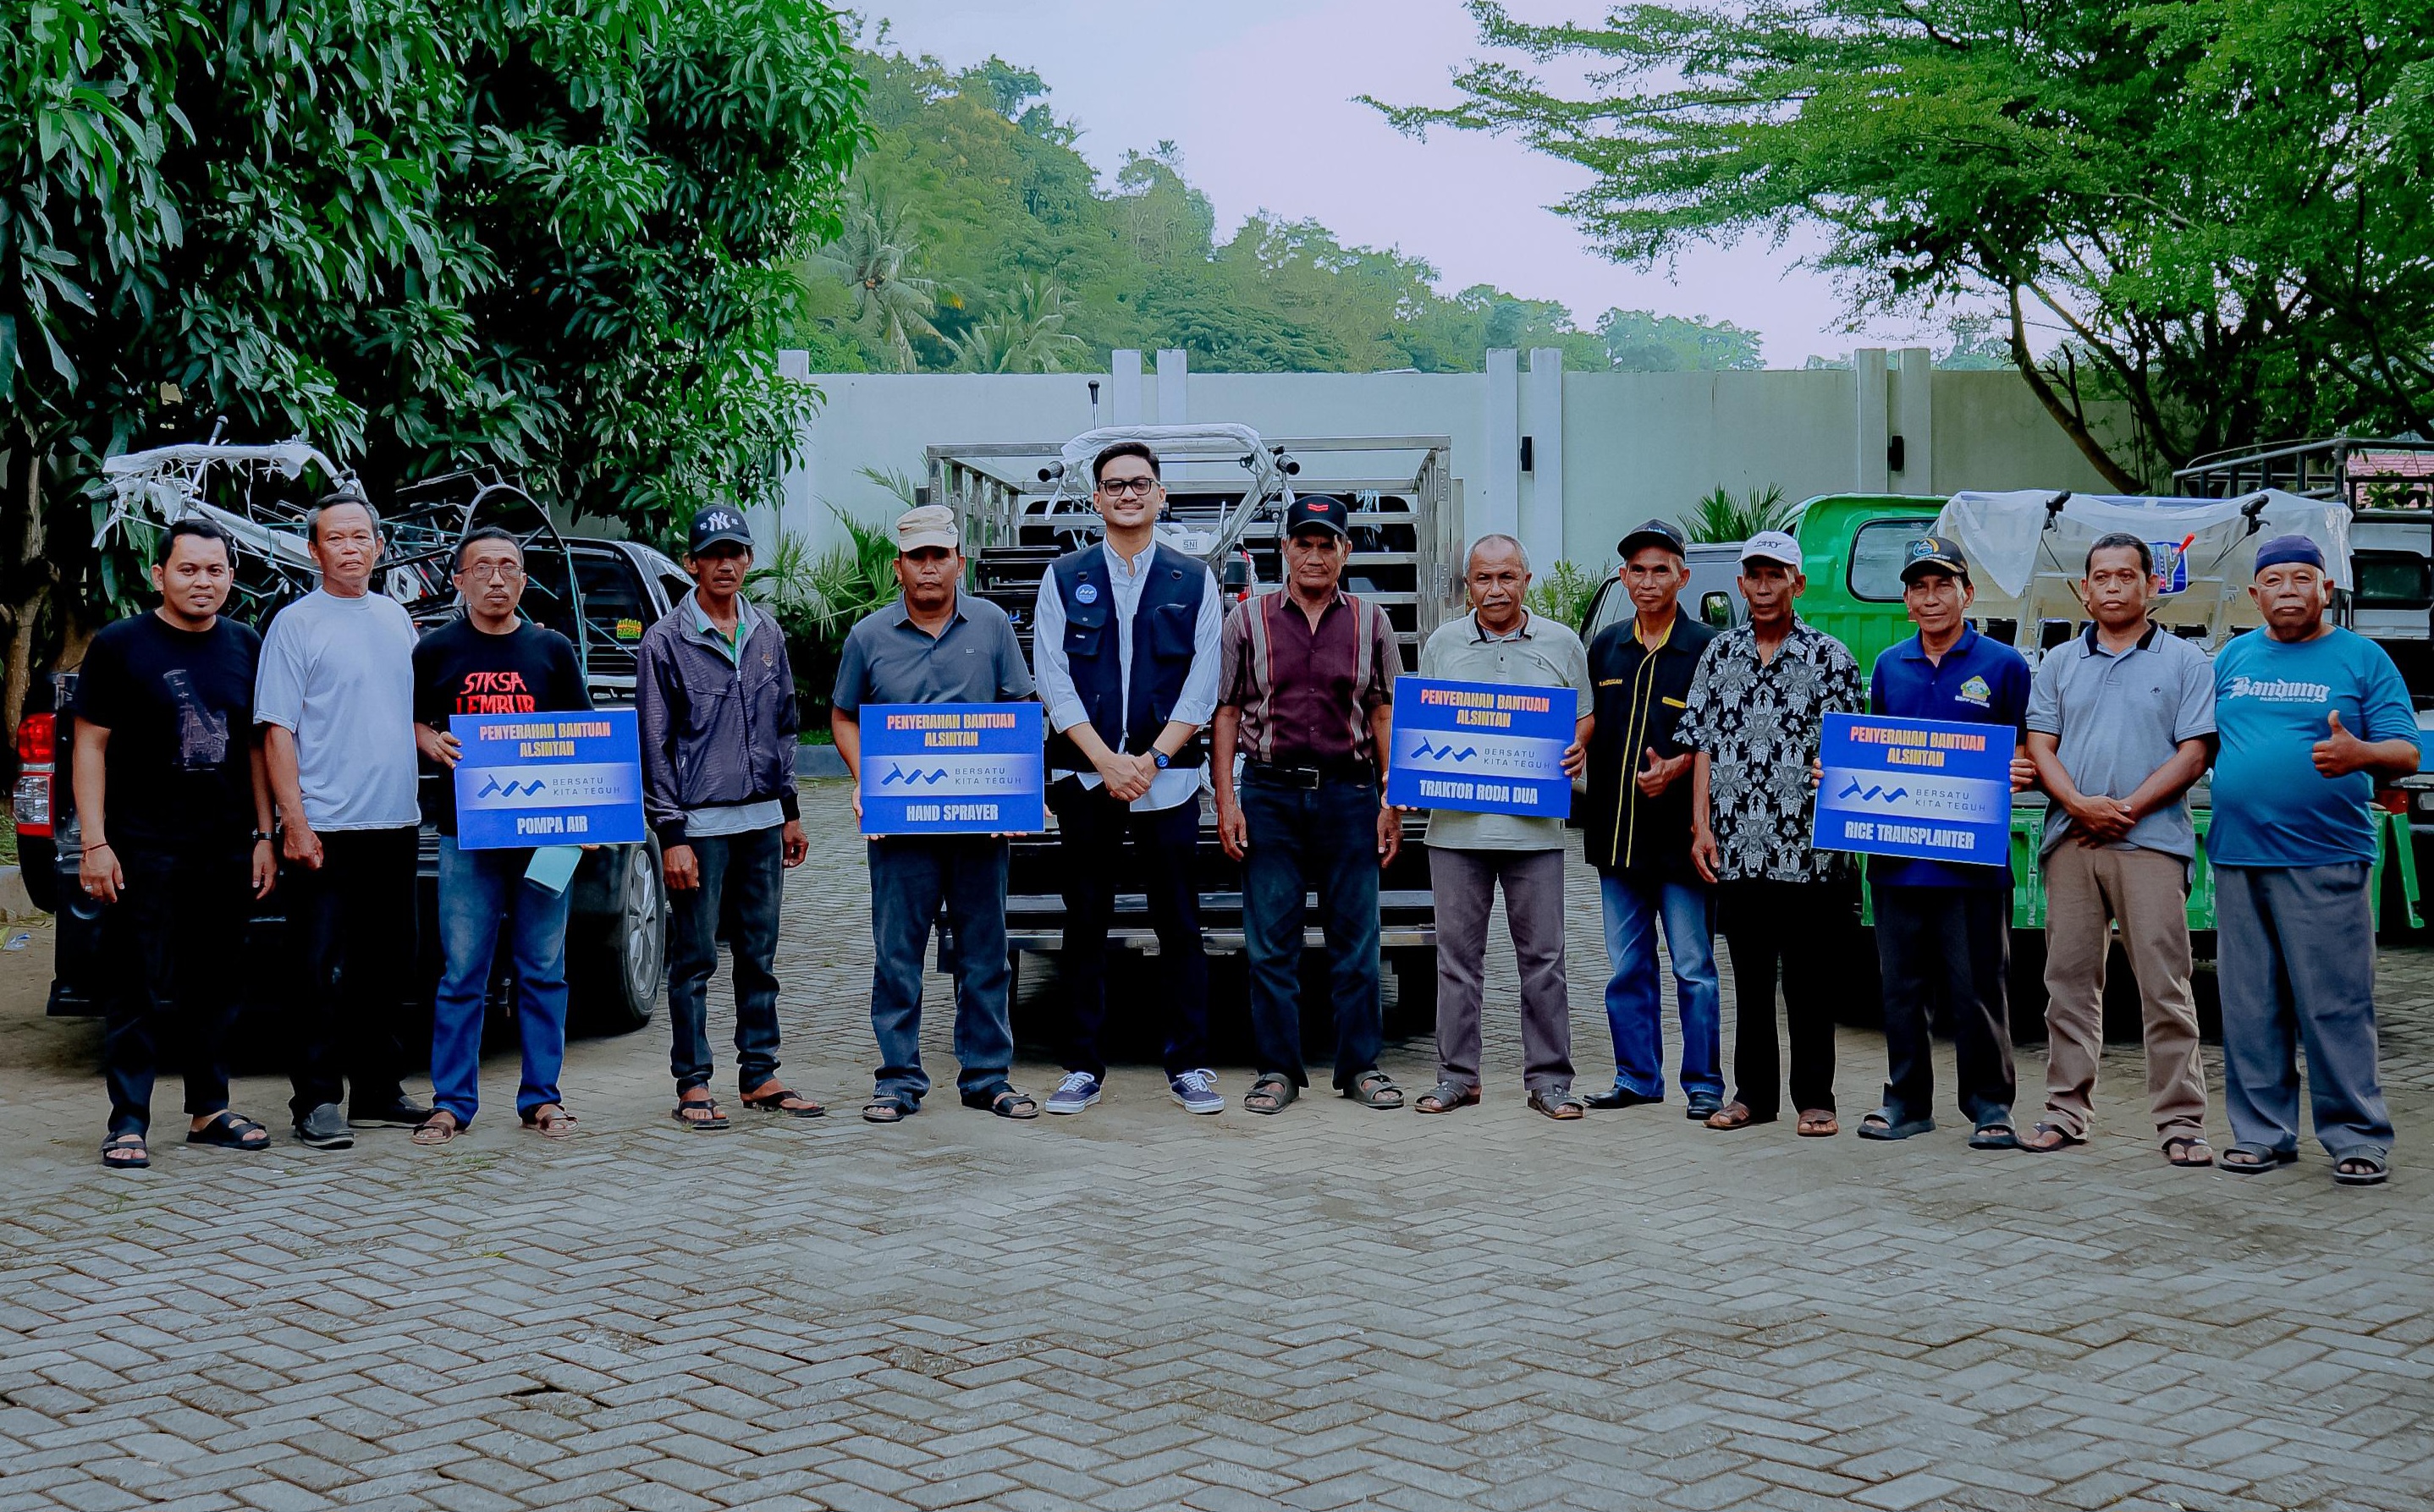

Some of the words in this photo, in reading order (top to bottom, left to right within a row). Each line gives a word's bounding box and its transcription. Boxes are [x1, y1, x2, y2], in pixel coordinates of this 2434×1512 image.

[460, 672, 527, 695] SIKSA
[2229, 677, 2331, 702] Bandung
[1421, 689, 1495, 708] PENYERAHAN
[1497, 695, 1550, 712] BANTUAN
[887, 714, 961, 730] PENYERAHAN
[963, 713, 1016, 729] BANTUAN
[1457, 709, 1512, 728] ALSINTAN
[480, 723, 555, 740] PENYERAHAN
[558, 723, 611, 739] BANTUAN
[924, 732, 978, 747] ALSINTAN
[1850, 726, 1927, 747] PENYERAHAN
[1930, 732, 1986, 751] BANTUAN
[520, 741, 575, 757] ALSINTAN
[1484, 748, 1535, 758] BERSATU
[1886, 747, 1945, 767] ALSINTAN
[1484, 758, 1508, 767] KITA
[1514, 761, 1550, 769] TEGUH
[553, 777, 603, 786] BERSATU
[584, 787, 620, 795] TEGUH
[1419, 779, 1473, 799] TRAKTOR
[1476, 783, 1510, 802] RODA
[1512, 787, 1539, 805] DUA
[1916, 789, 1969, 800] BERSATU
[906, 805, 940, 822] HAND
[943, 804, 999, 821] SPRAYER
[1915, 800, 1941, 808] KITA
[1947, 802, 1985, 811] TEGUH
[517, 816, 564, 835] POMPA
[566, 816, 588, 833] AIR
[1844, 821, 1874, 840] RICE
[1876, 823, 1975, 849] TRANSPLANTER
